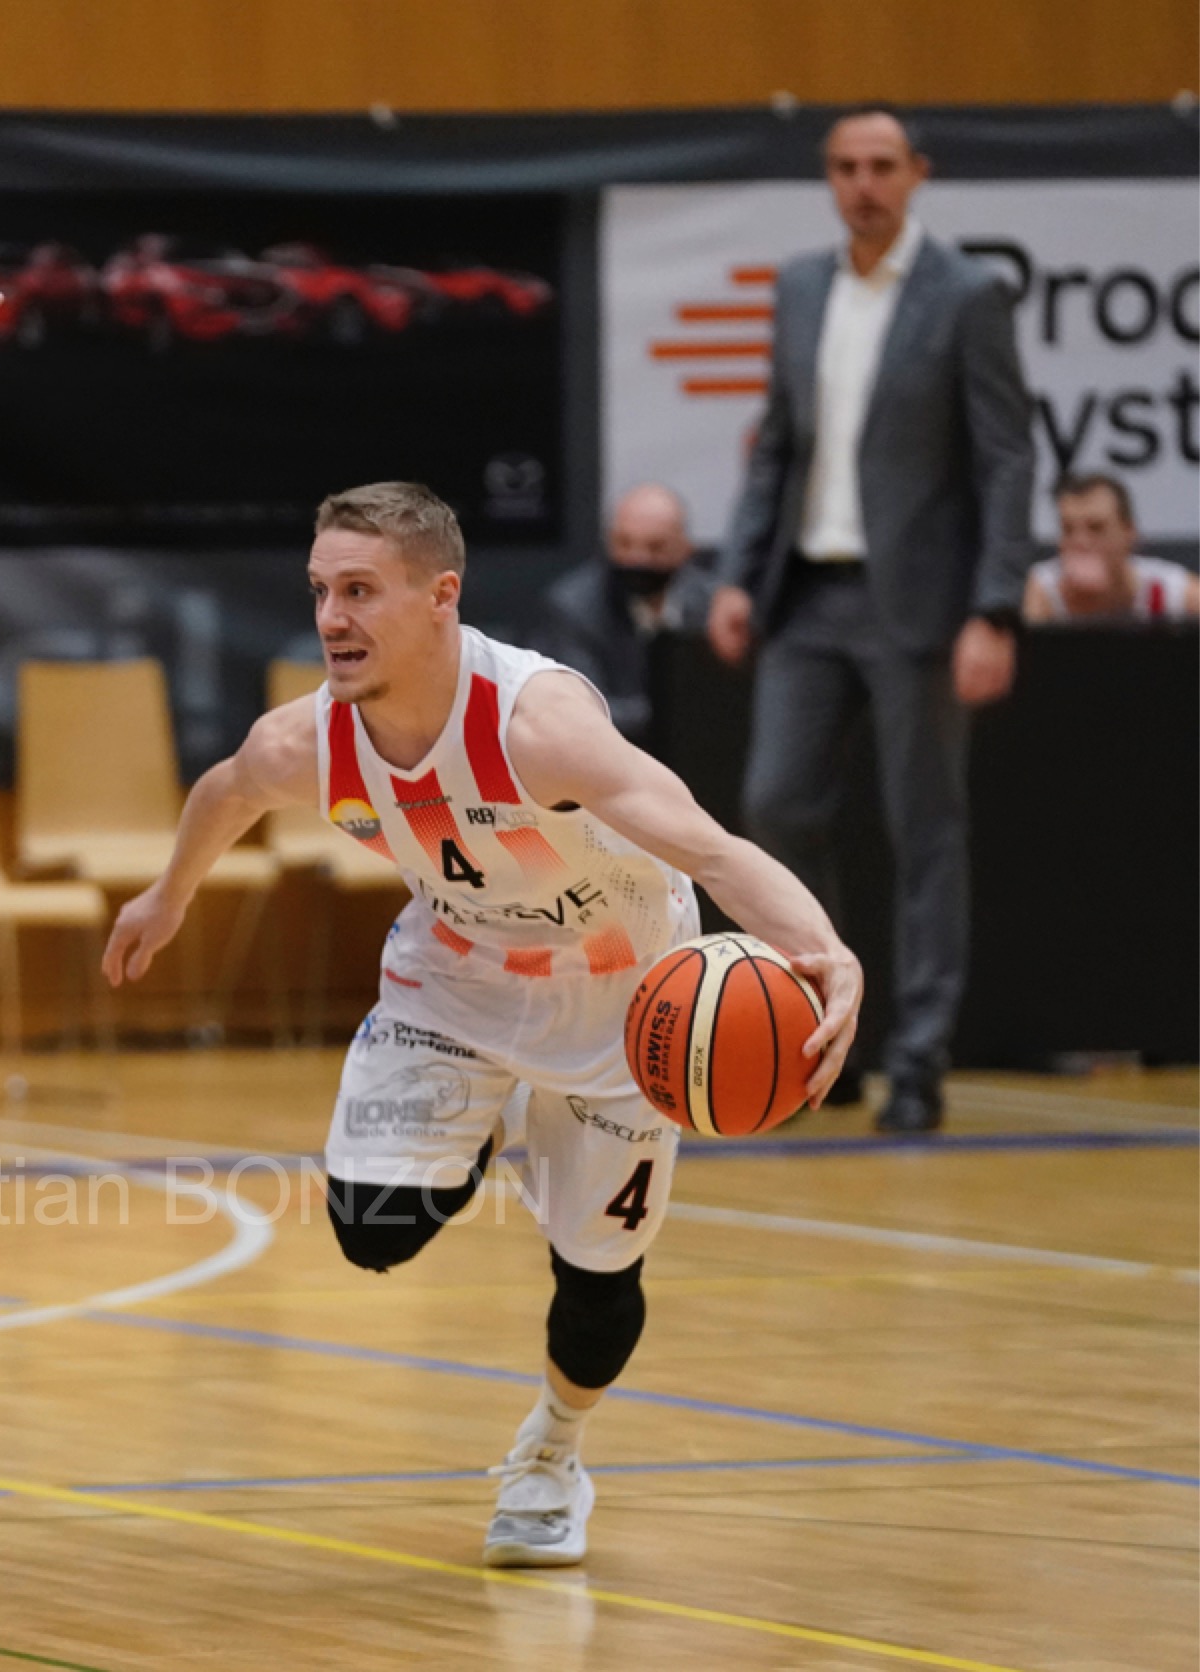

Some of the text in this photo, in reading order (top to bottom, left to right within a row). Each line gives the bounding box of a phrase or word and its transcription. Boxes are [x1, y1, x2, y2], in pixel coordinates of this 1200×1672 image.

[465, 807, 495, 825] RB
[441, 839, 486, 888] 4
[647, 1000, 672, 1080] SWISS
[604, 1159, 654, 1231] 4
